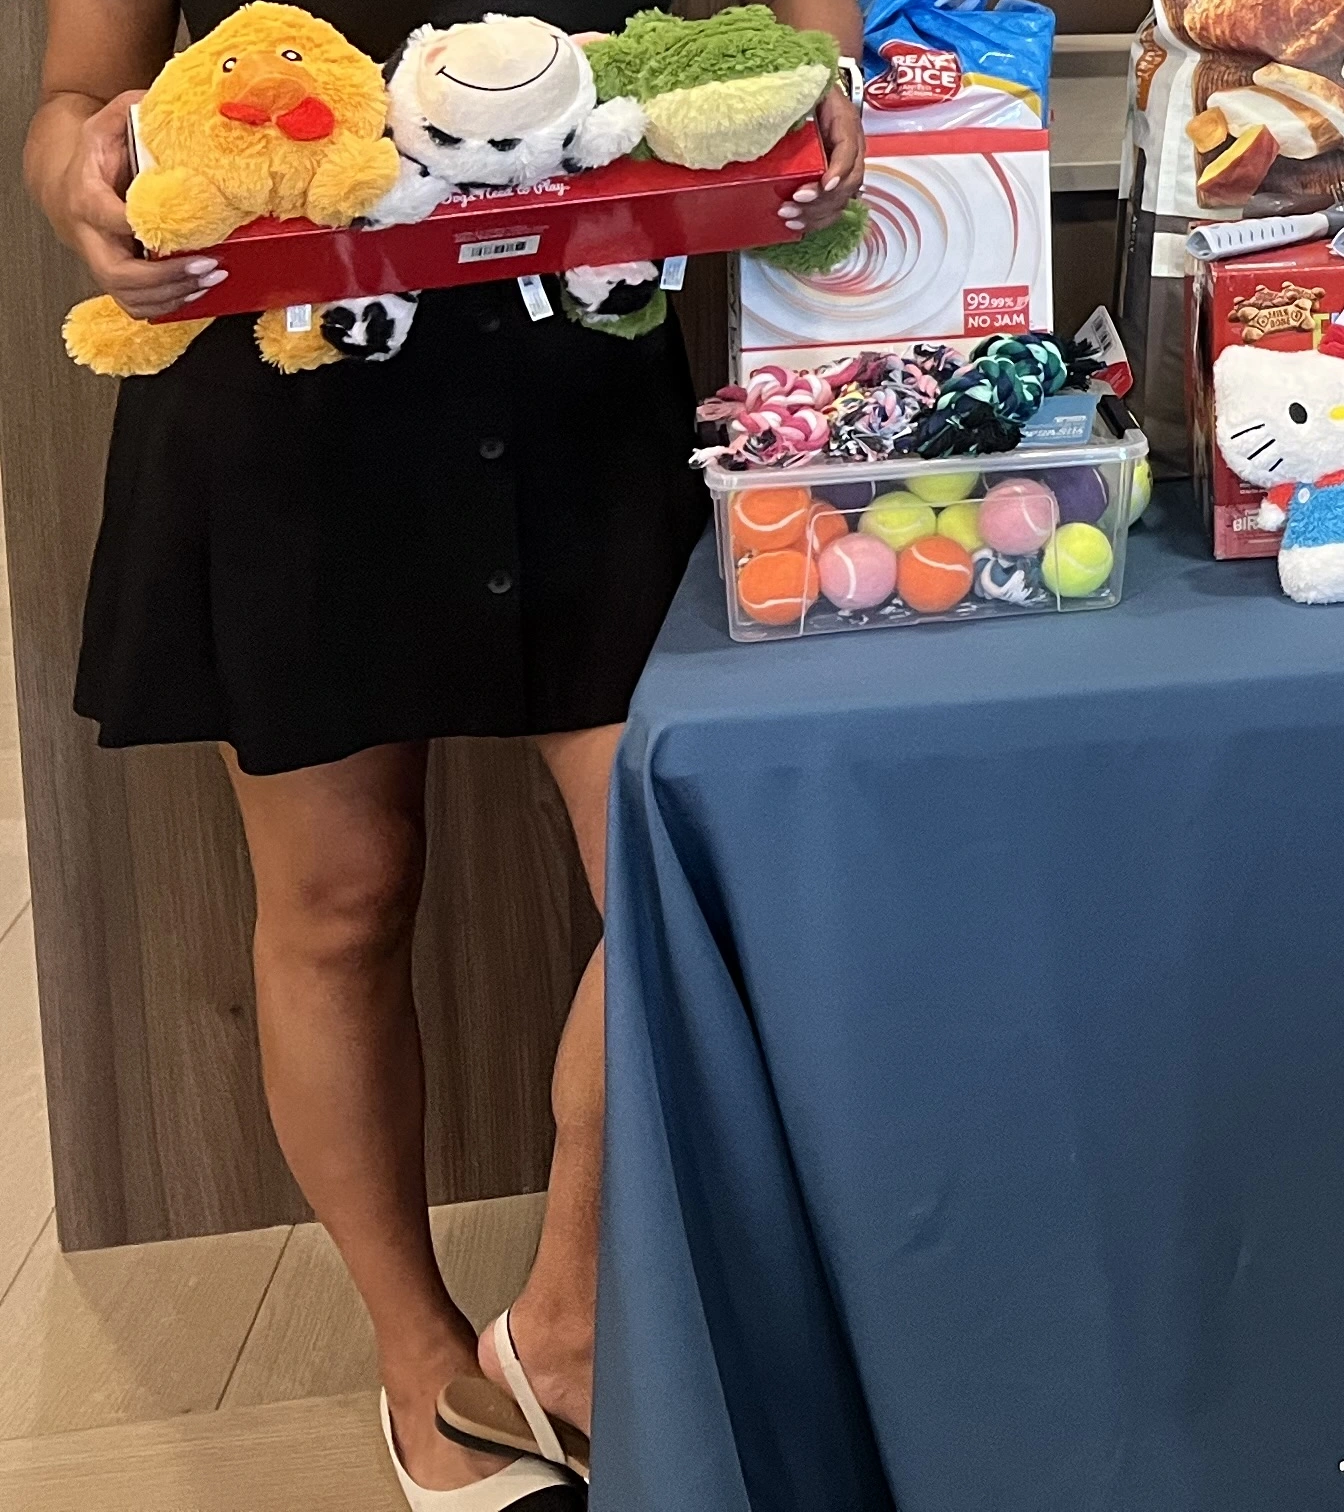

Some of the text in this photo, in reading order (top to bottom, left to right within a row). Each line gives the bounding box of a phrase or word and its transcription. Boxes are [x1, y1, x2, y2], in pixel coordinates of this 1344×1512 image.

[892, 54, 955, 69] REAT
[966, 292, 1014, 310] 99.99%
[968, 313, 1025, 328] NO JAM
[1268, 309, 1289, 318] MILK
